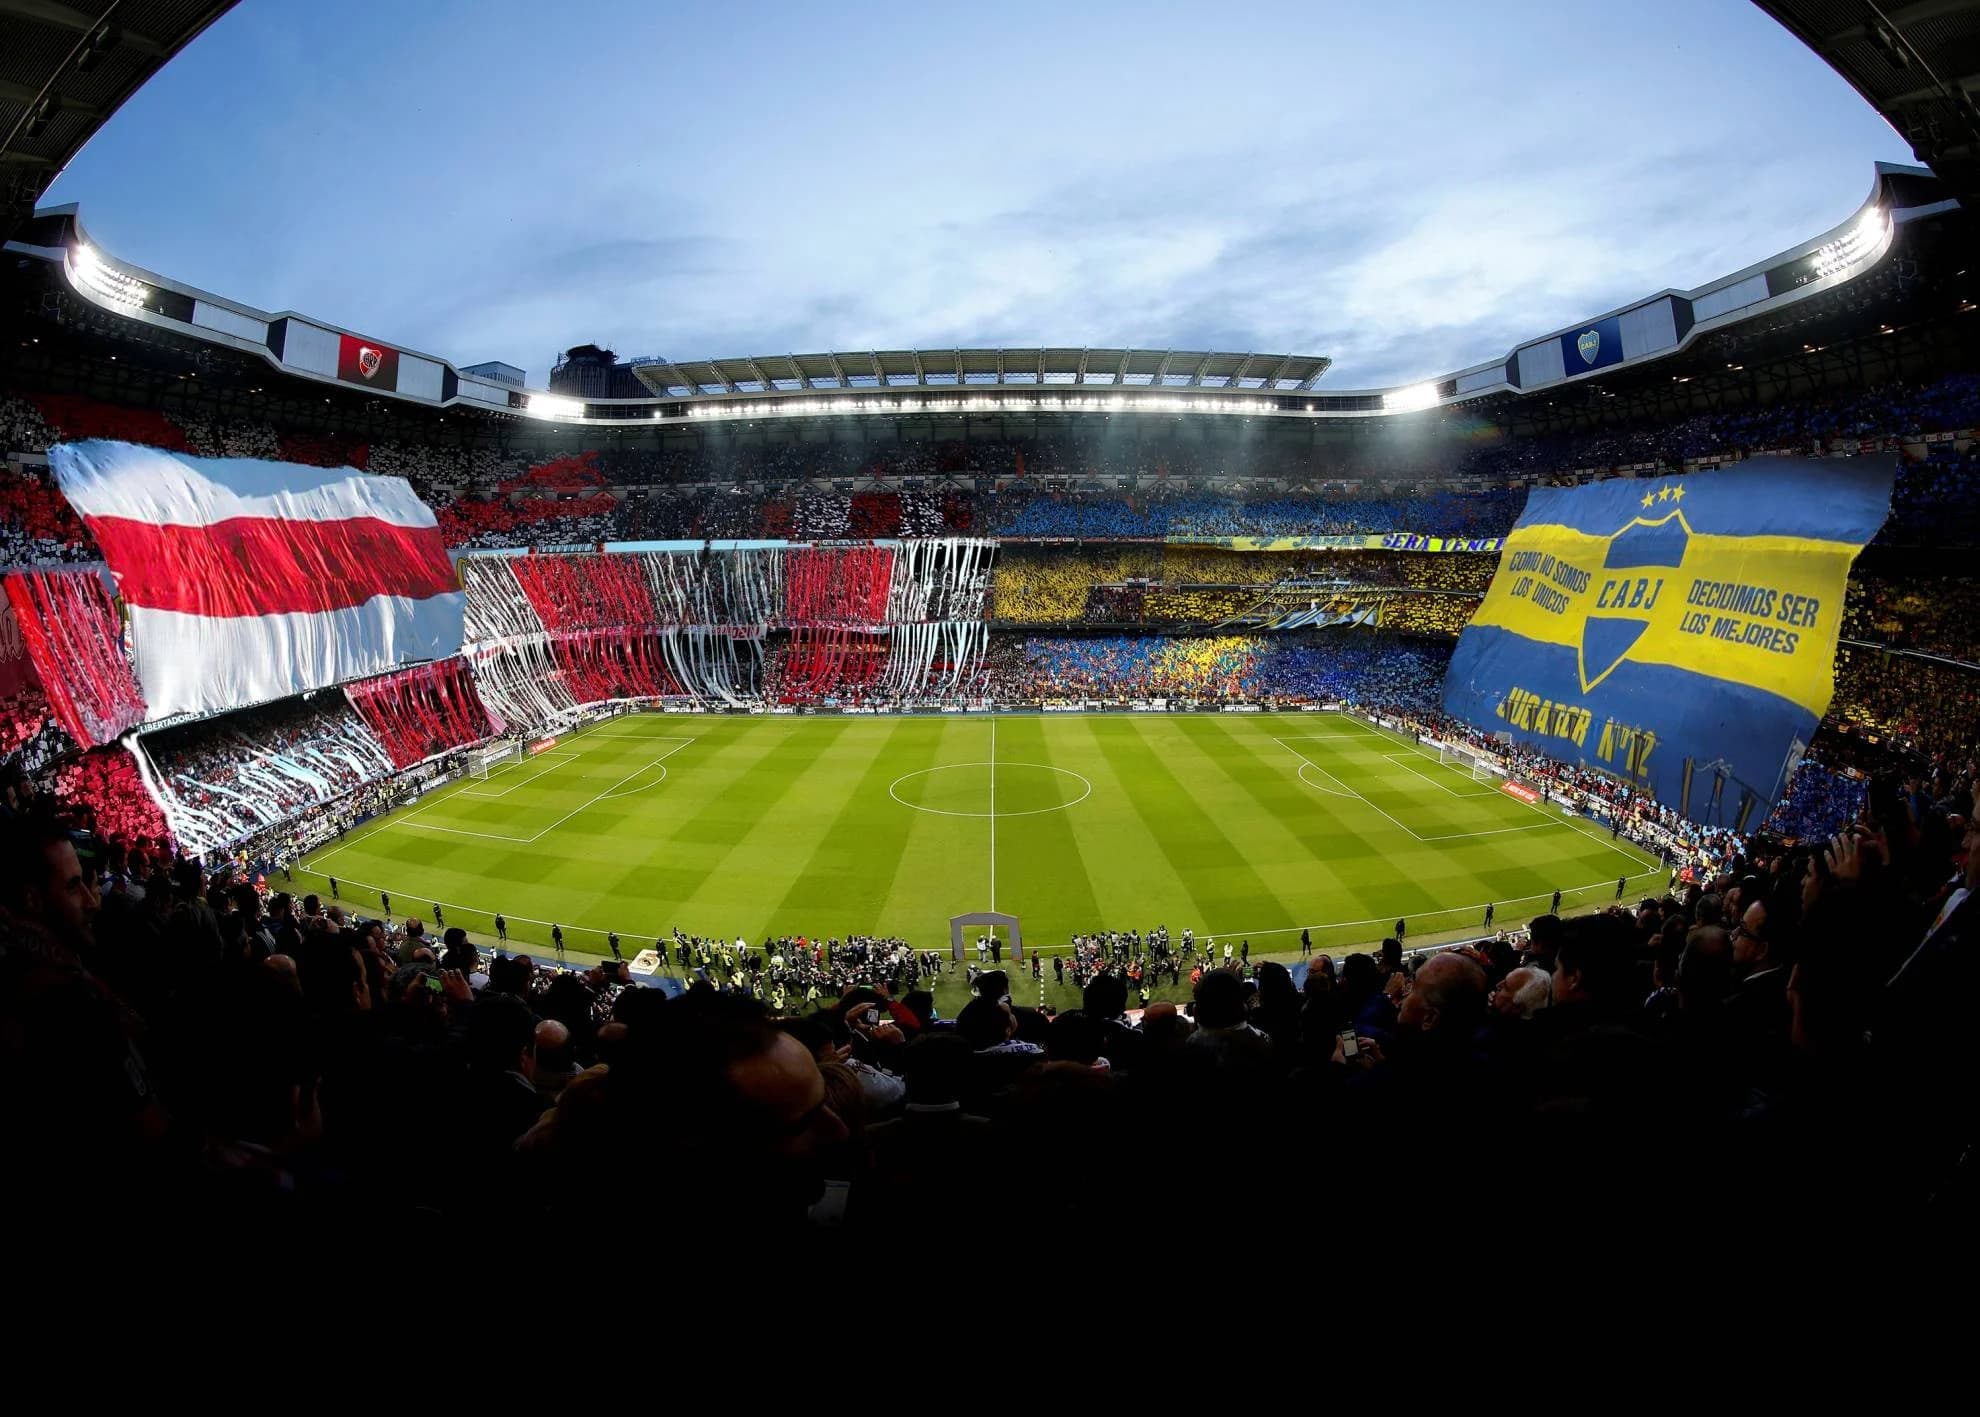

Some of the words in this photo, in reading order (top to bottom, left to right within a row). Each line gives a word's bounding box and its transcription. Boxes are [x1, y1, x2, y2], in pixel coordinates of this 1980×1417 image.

[1509, 551, 1543, 572] COMO
[1539, 554, 1556, 577] NO
[1552, 560, 1592, 594] SOMOS
[1510, 576, 1533, 598] LOS
[1532, 581, 1570, 615] UNICOS
[1596, 578, 1664, 610] CABJ
[1686, 578, 1778, 618] DECIDIMOS
[1776, 592, 1820, 628] SER
[1679, 611, 1711, 635] LOS
[1710, 616, 1800, 654] MEJORES
[140, 711, 200, 734] LIBERTADORES
